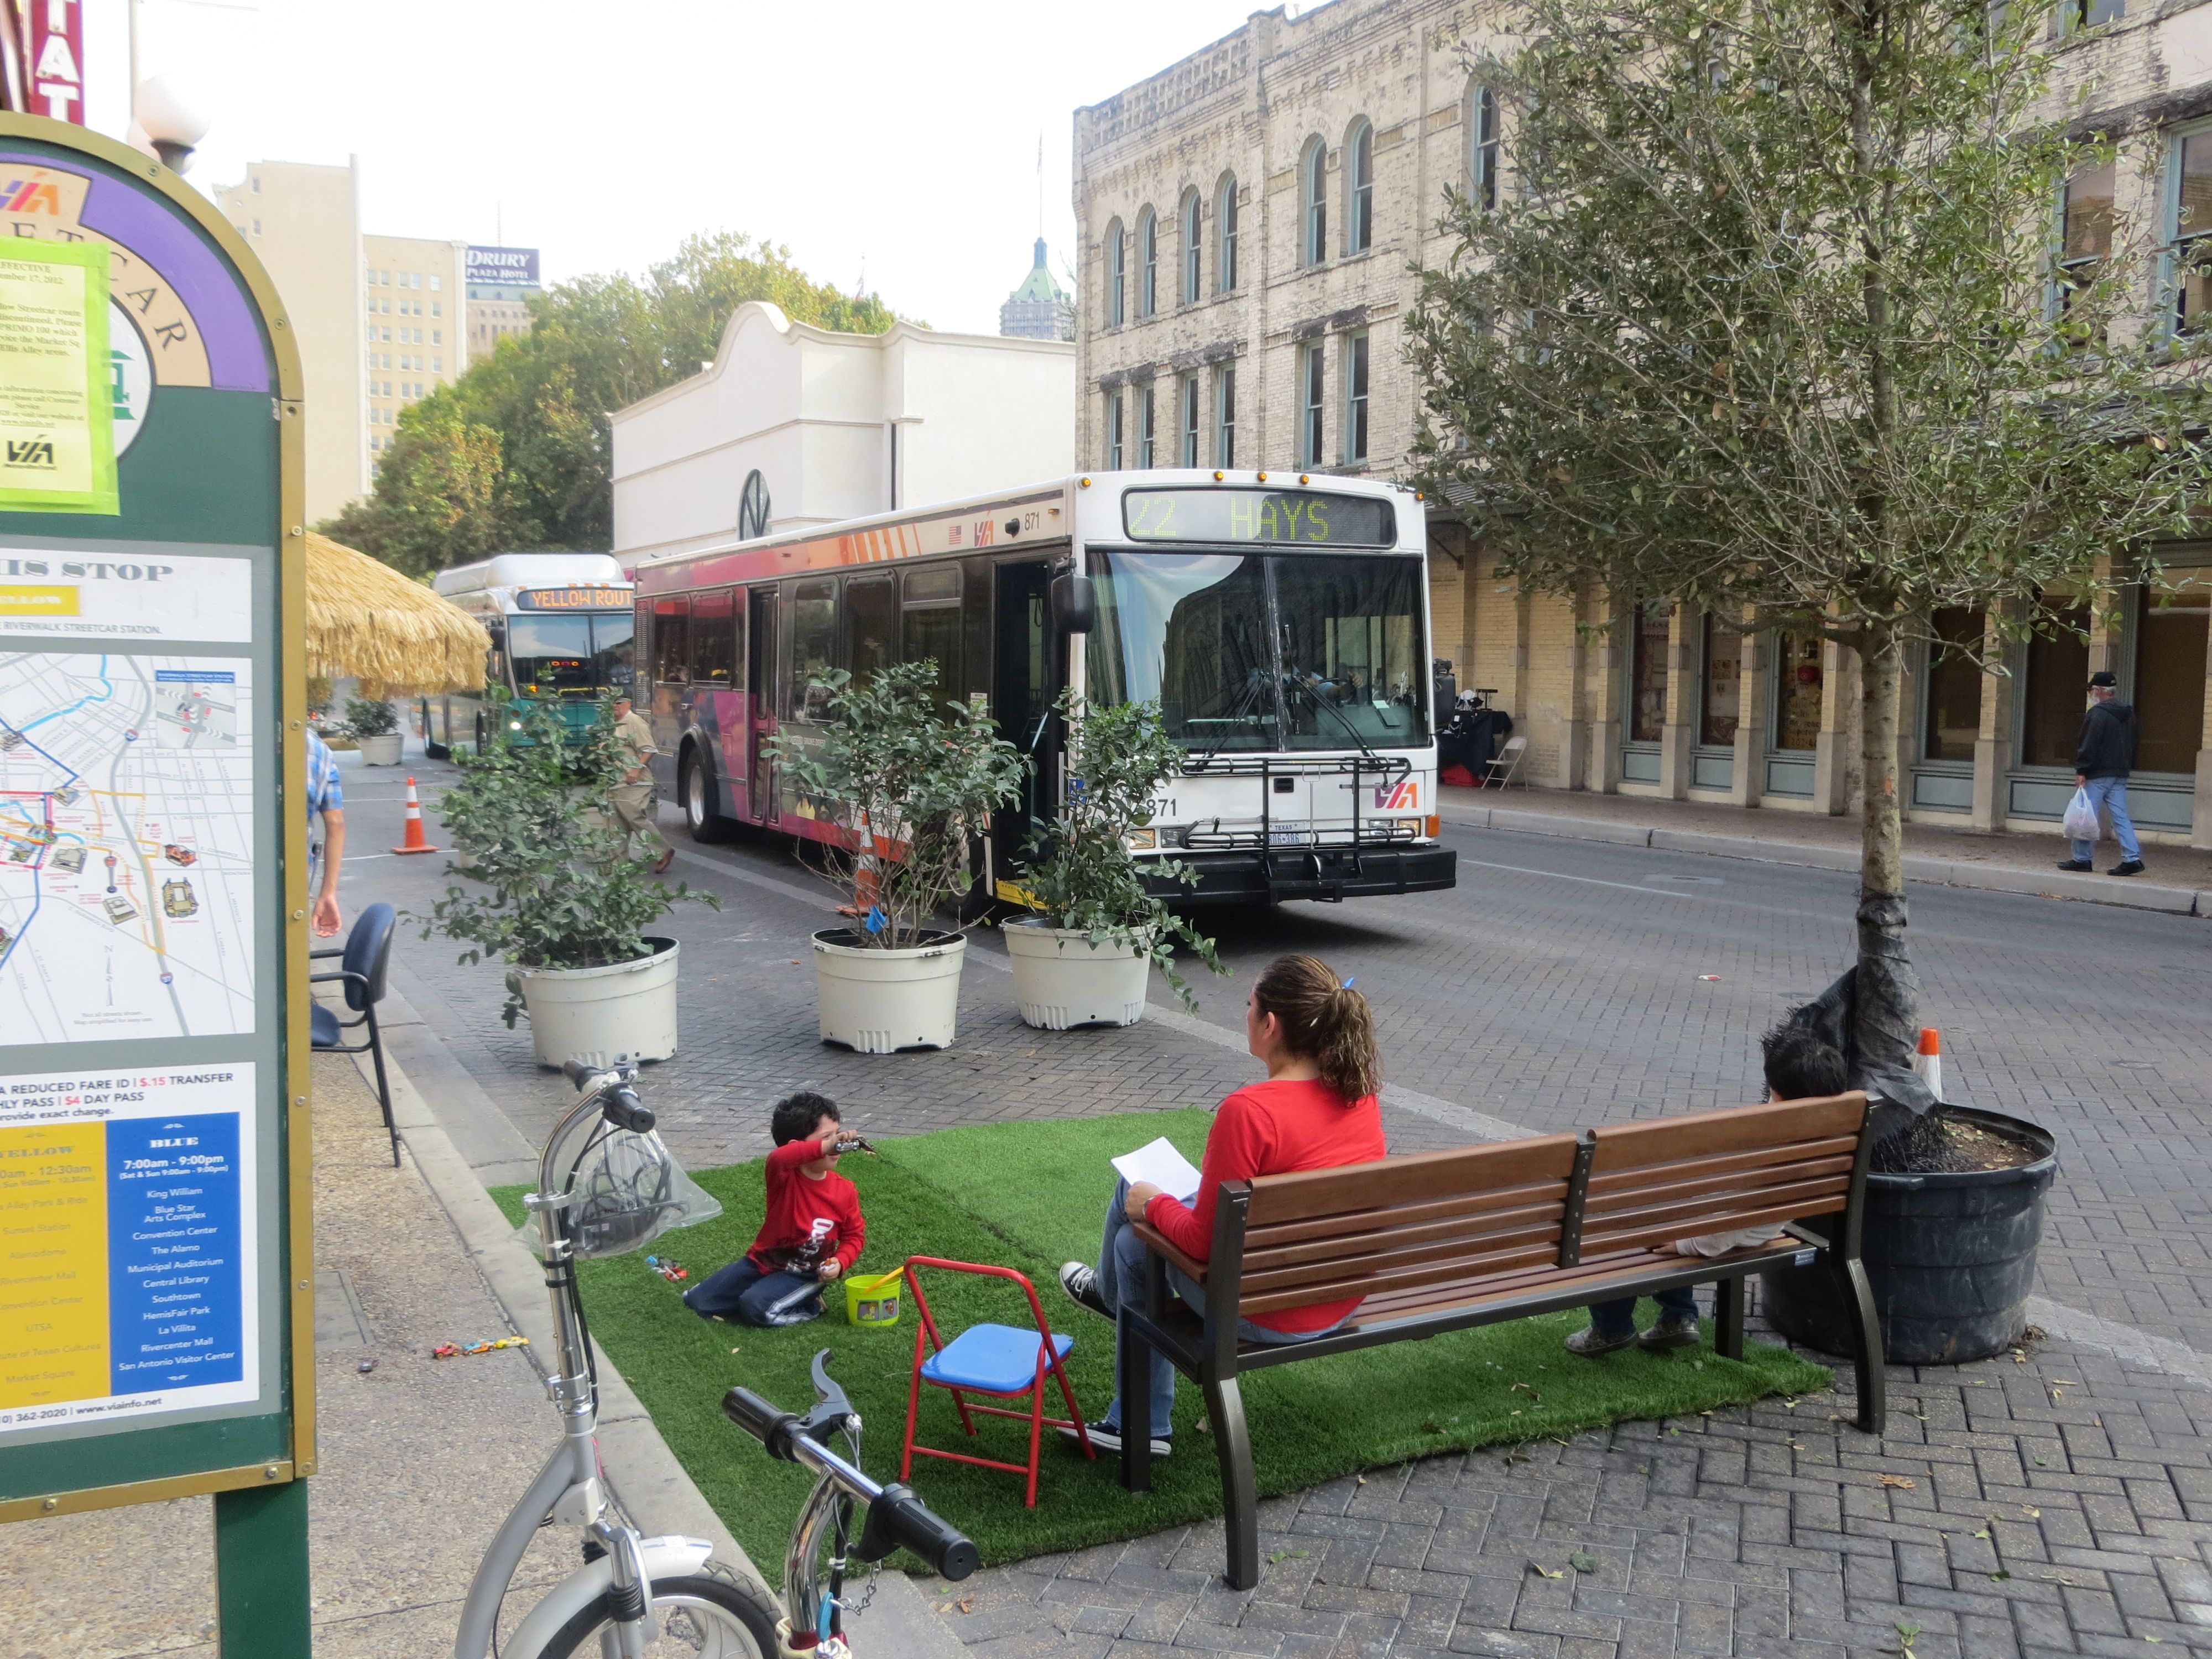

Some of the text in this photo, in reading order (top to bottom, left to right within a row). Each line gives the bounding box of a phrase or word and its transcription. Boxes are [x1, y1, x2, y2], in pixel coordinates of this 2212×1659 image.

[467, 250, 530, 268] DRURY
[467, 267, 529, 279] PLAZA HOTEL
[1126, 497, 1329, 541] 22 HAYS
[974, 510, 1040, 547] VIA 871
[61, 561, 173, 582] STOP
[531, 589, 633, 607] YELLOW ROUT
[3, 621, 62, 632] RIVERWALK
[64, 623, 118, 633] STREETCAR
[1375, 782, 1417, 809] VIA
[1146, 799, 1176, 817] 871
[11, 1082, 75, 1094] REDUCED
[80, 1079, 112, 1090] FARE
[117, 1079, 130, 1088] ID
[140, 1077, 165, 1087] $.15
[169, 1073, 233, 1085] TRANSFER
[23, 1097, 55, 1108] PASS
[65, 1095, 80, 1105] $4
[84, 1094, 111, 1104] DAY
[114, 1091, 144, 1102] PASS
[39, 1109, 69, 1119] exact
[72, 1107, 114, 1117] change.
[149, 1136, 199, 1149] BLUE
[39, 1165, 91, 1175] 12:30am
[123, 1159, 169, 1170] 7:00am
[179, 1155, 224, 1166] 9:00pm
[147, 1188, 203, 1199] King William
[155, 1204, 196, 1214] Blue Star
[166, 1211, 206, 1222] Complex
[132, 1227, 218, 1240] Convention Center
[152, 1244, 200, 1255] The Alamo
[128, 1258, 223, 1273] Municipal Auditorium
[143, 1276, 210, 1288] Central Library
[152, 1292, 201, 1303] Southtown
[143, 1306, 211, 1320] HemisFair Park
[27, 1323, 53, 1332] UTSA
[171, 1324, 196, 1333] Villita
[141, 1337, 213, 1352] Rivercenter Mall
[119, 1351, 235, 1371] San Antonio Visitor Center
[16, 1408, 67, 1422] 362-2020
[76, 1398, 162, 1414] www.viainfo.net
